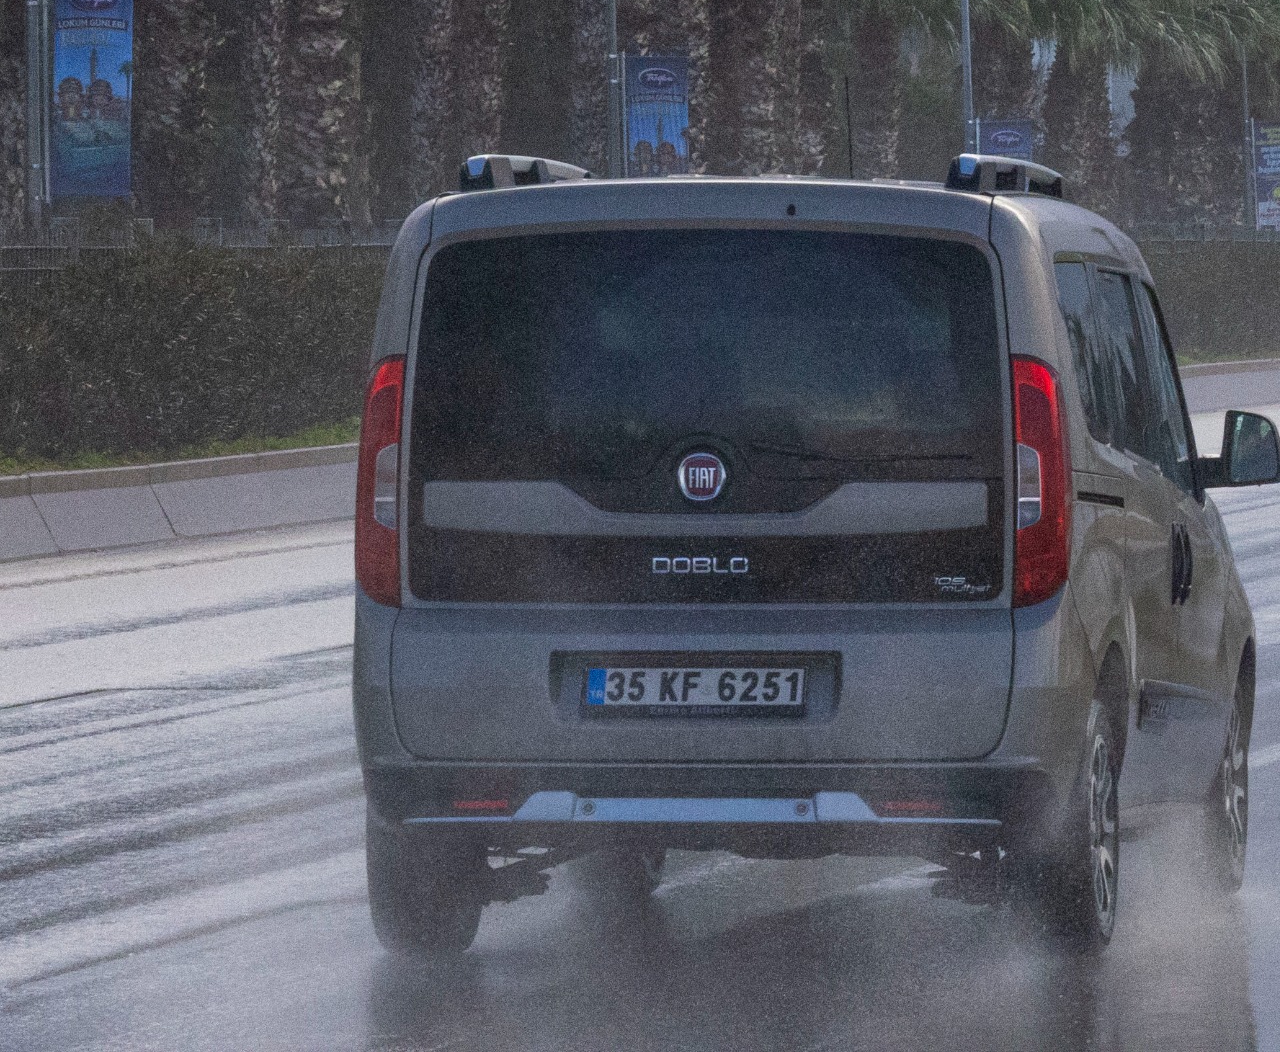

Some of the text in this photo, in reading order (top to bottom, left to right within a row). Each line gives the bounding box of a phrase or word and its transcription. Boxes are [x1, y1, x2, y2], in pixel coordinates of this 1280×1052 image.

[688, 467, 717, 489] FIAT
[606, 671, 800, 702] 35 KF 6251
